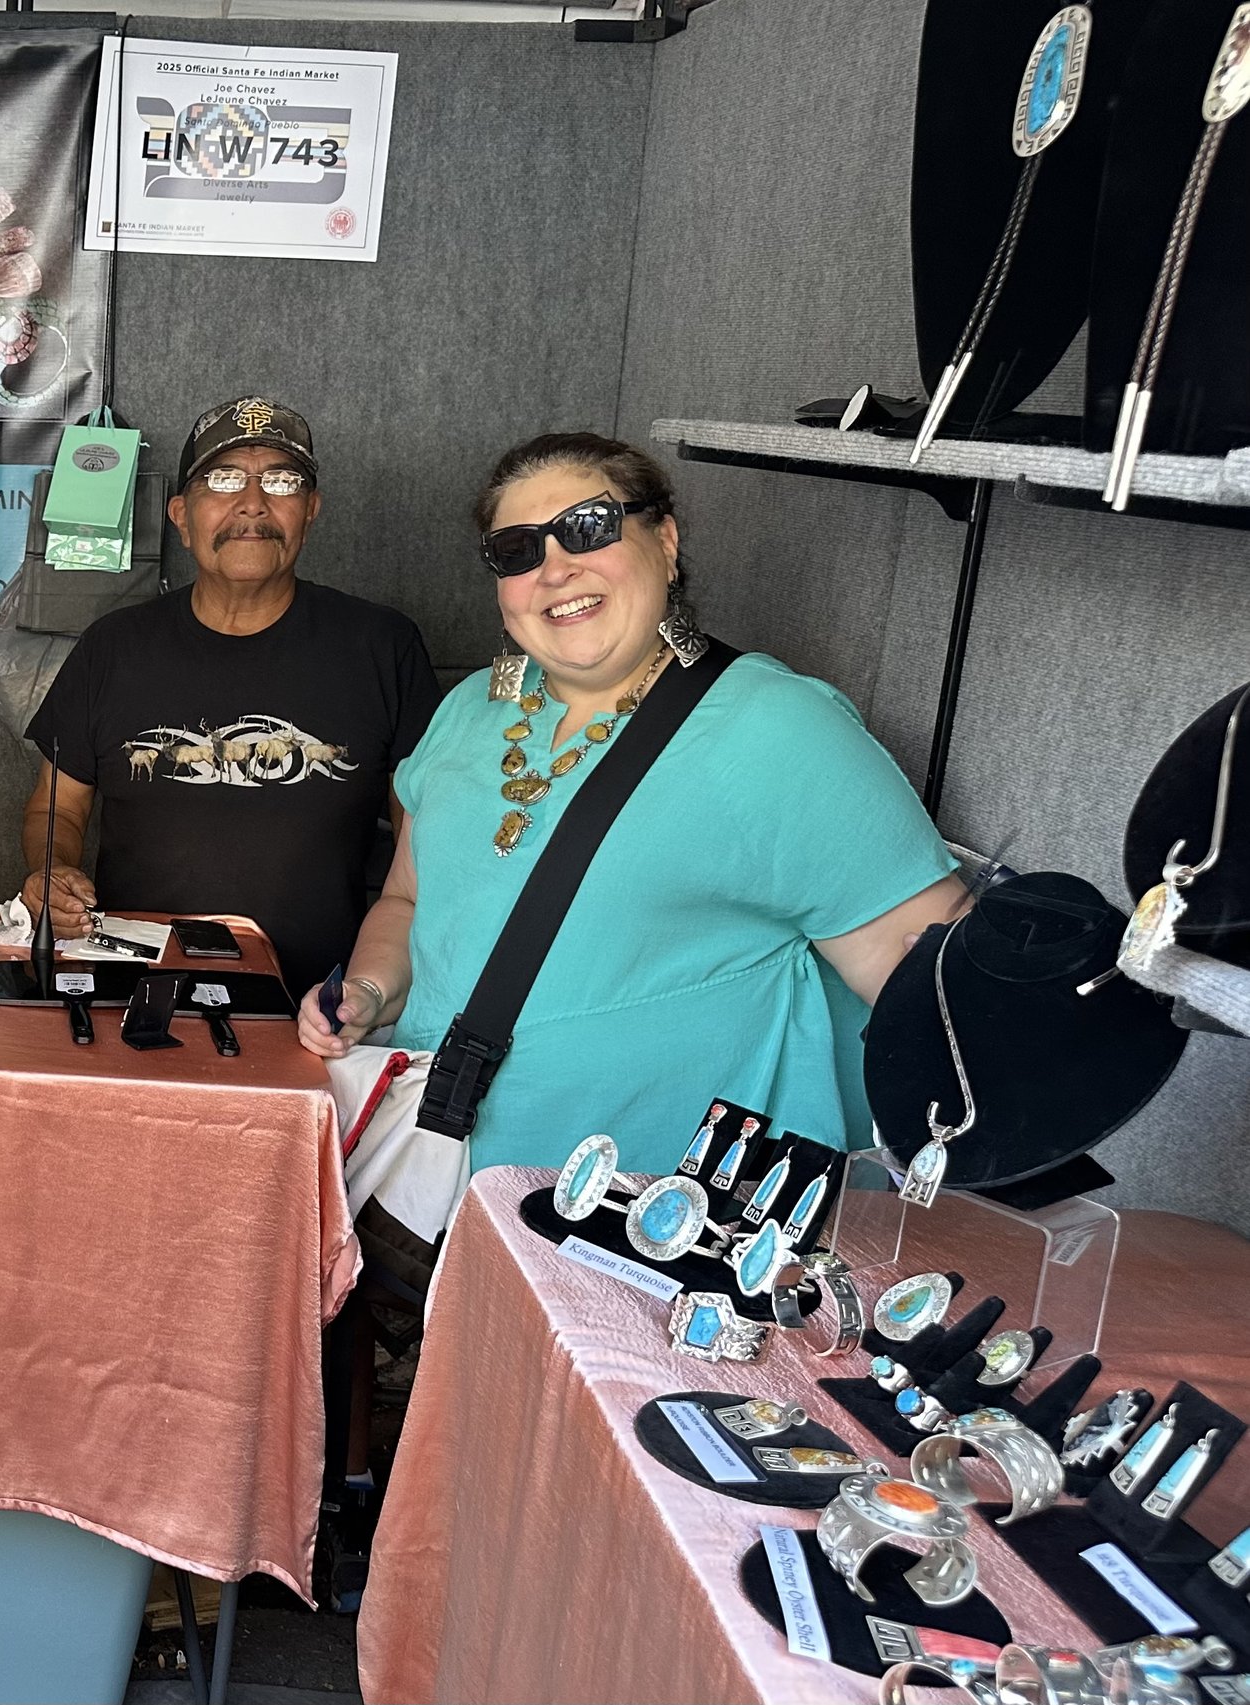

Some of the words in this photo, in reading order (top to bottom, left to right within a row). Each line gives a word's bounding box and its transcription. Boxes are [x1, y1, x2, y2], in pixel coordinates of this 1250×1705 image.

[156, 62, 181, 72] 2025
[185, 64, 218, 74] Official
[222, 66, 250, 76] Santa
[253, 68, 266, 77] Fe
[269, 68, 301, 78] Indian
[304, 70, 339, 79] Market
[214, 83, 232, 93] Joe
[236, 84, 276, 94] Chavez
[200, 94, 244, 104] LeJeune
[248, 96, 288, 106] Chavez
[264, 120, 300, 130] Pueblo
[141, 131, 201, 161] LIN
[219, 135, 254, 164] W
[269, 137, 339, 167] 743
[203, 178, 243, 188] Diverse
[246, 180, 269, 190] Arts
[214, 192, 255, 204] Jewelry
[114, 222, 136, 230] ANTA
[568, 1242, 617, 1270] Kingman
[619, 1262, 673, 1292] Turquoise
[773, 1527, 795, 1556] Natural
[786, 1589, 806, 1621] Oyster
[796, 1621, 817, 1652] Shell
